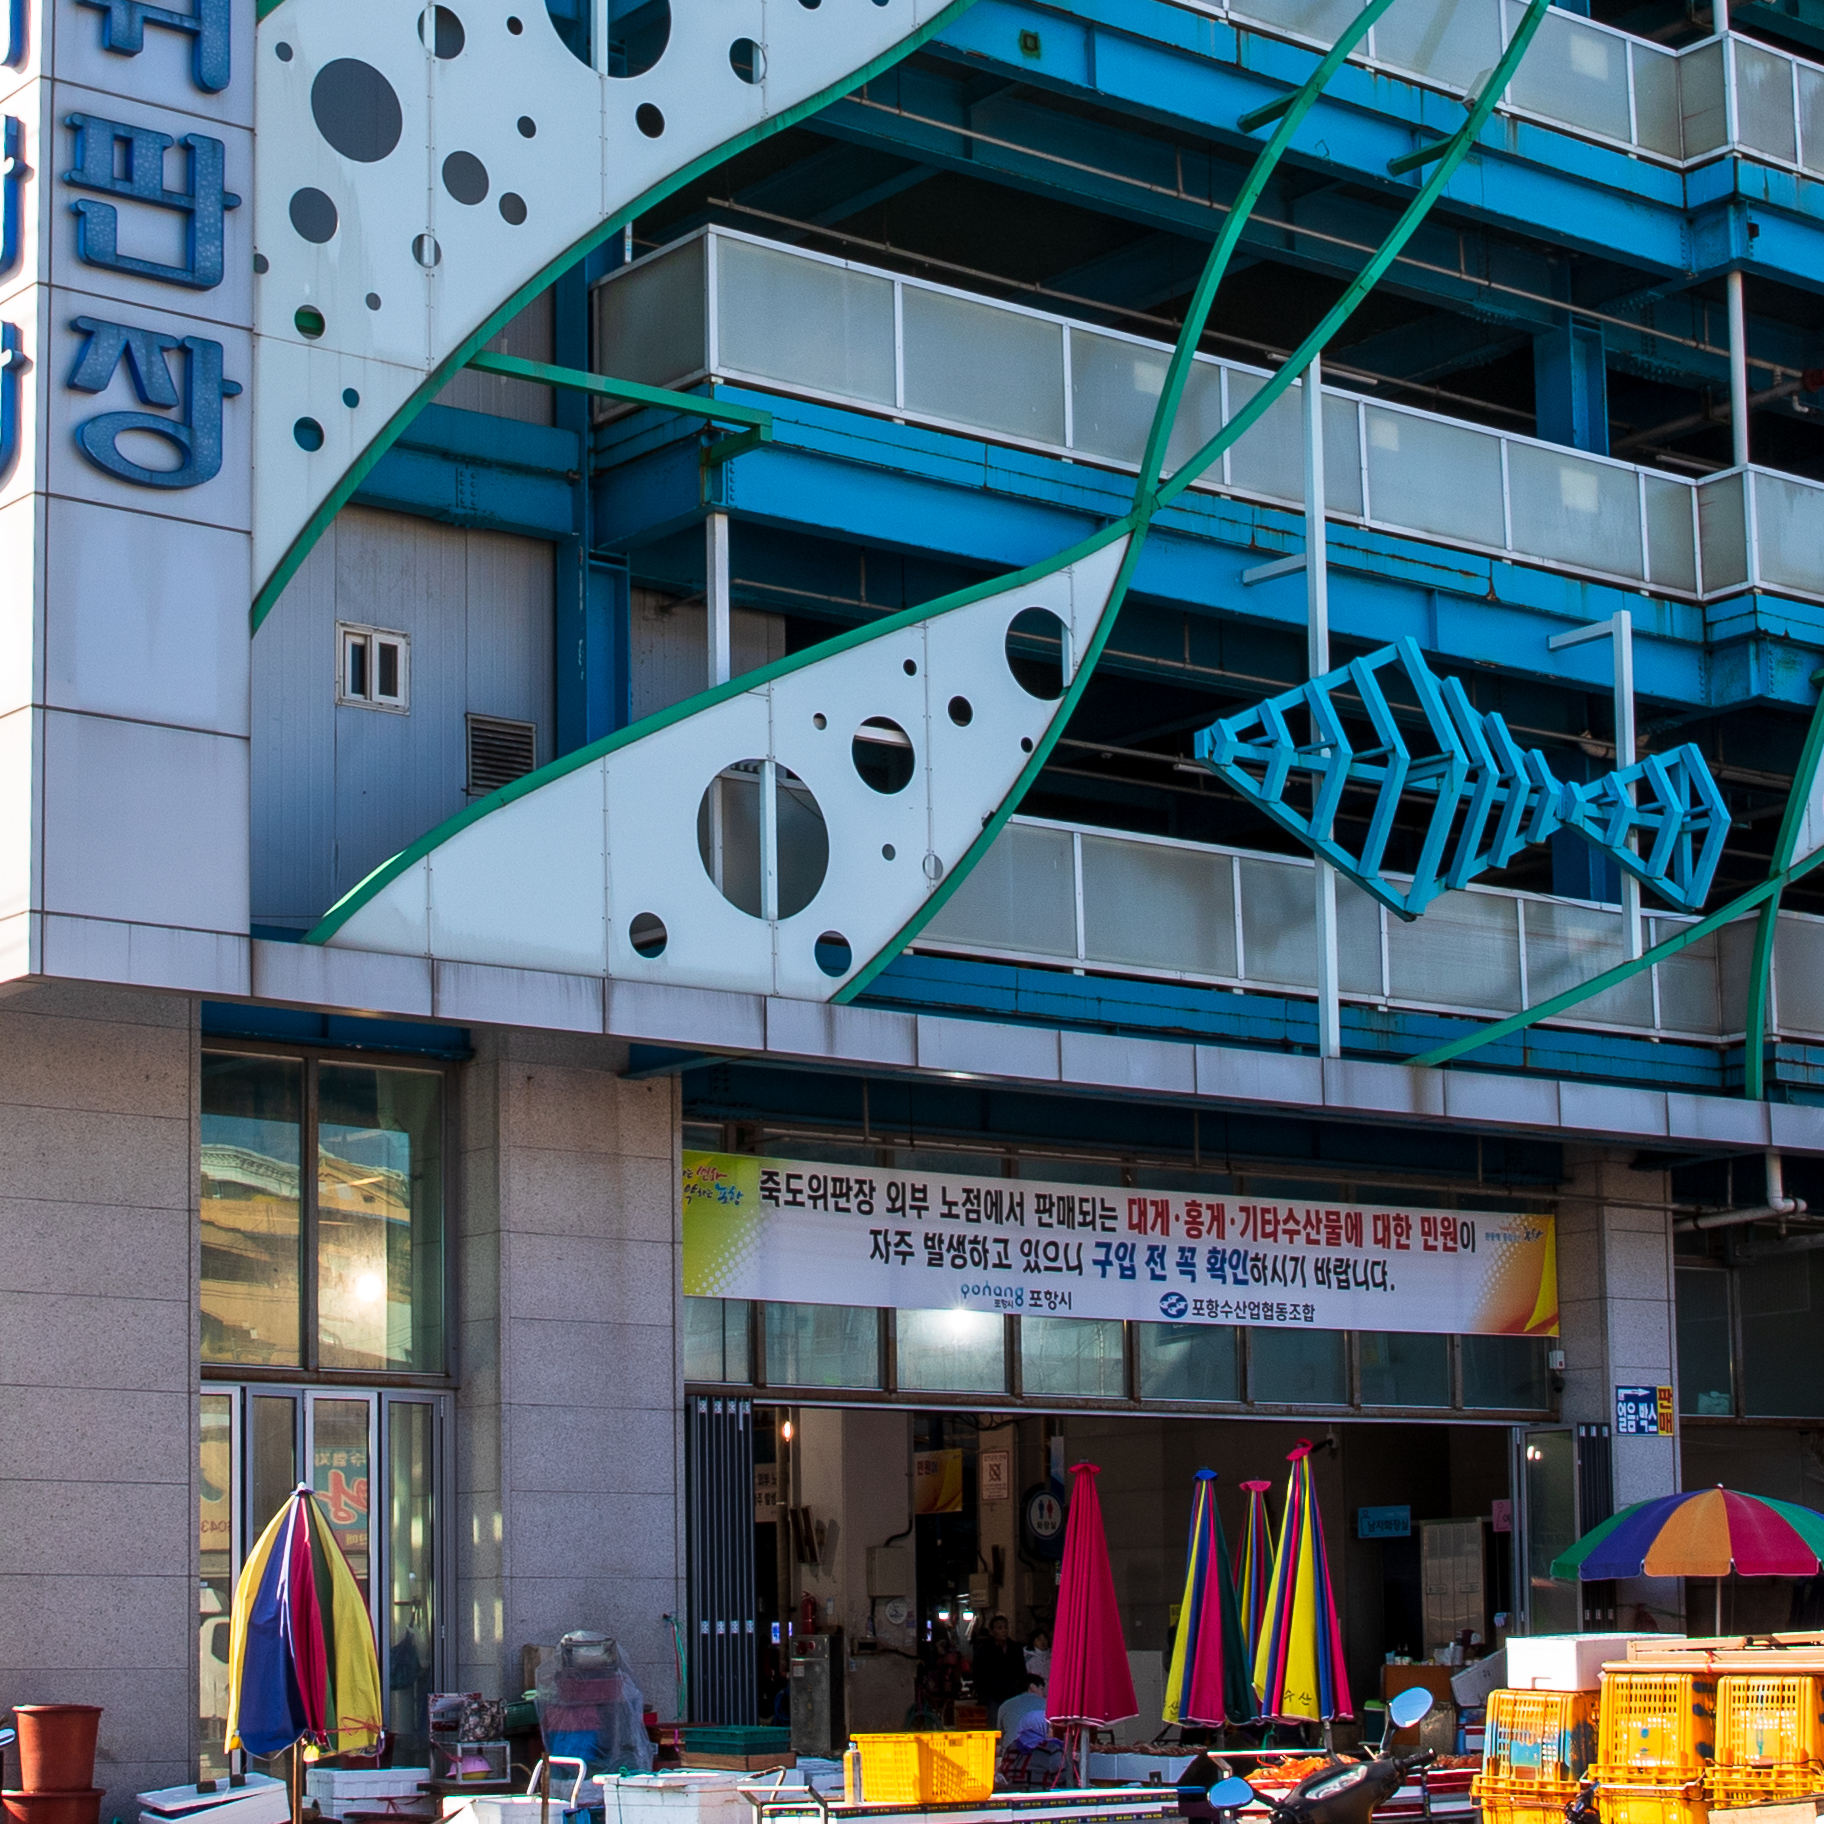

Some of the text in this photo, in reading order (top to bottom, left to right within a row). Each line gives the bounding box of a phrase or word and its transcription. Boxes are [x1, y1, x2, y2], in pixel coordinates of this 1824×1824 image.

[759, 1169, 876, 1216] 죽도위판장
[886, 1181, 930, 1220] 외부
[940, 1185, 1025, 1226] 노점에서
[1034, 1192, 1119, 1233] 판매되는
[1372, 1212, 1412, 1251] 대한
[1420, 1215, 1476, 1254] 민원이
[869, 1228, 1395, 1292] 자주 발생하고 있으니 구입 전 꼭 확인하시기 바랍니다.
[1029, 1289, 1072, 1311] 포항시
[1192, 1297, 1315, 1323] 포항수산업협동조합
[1658, 1388, 1673, 1433] 판매
